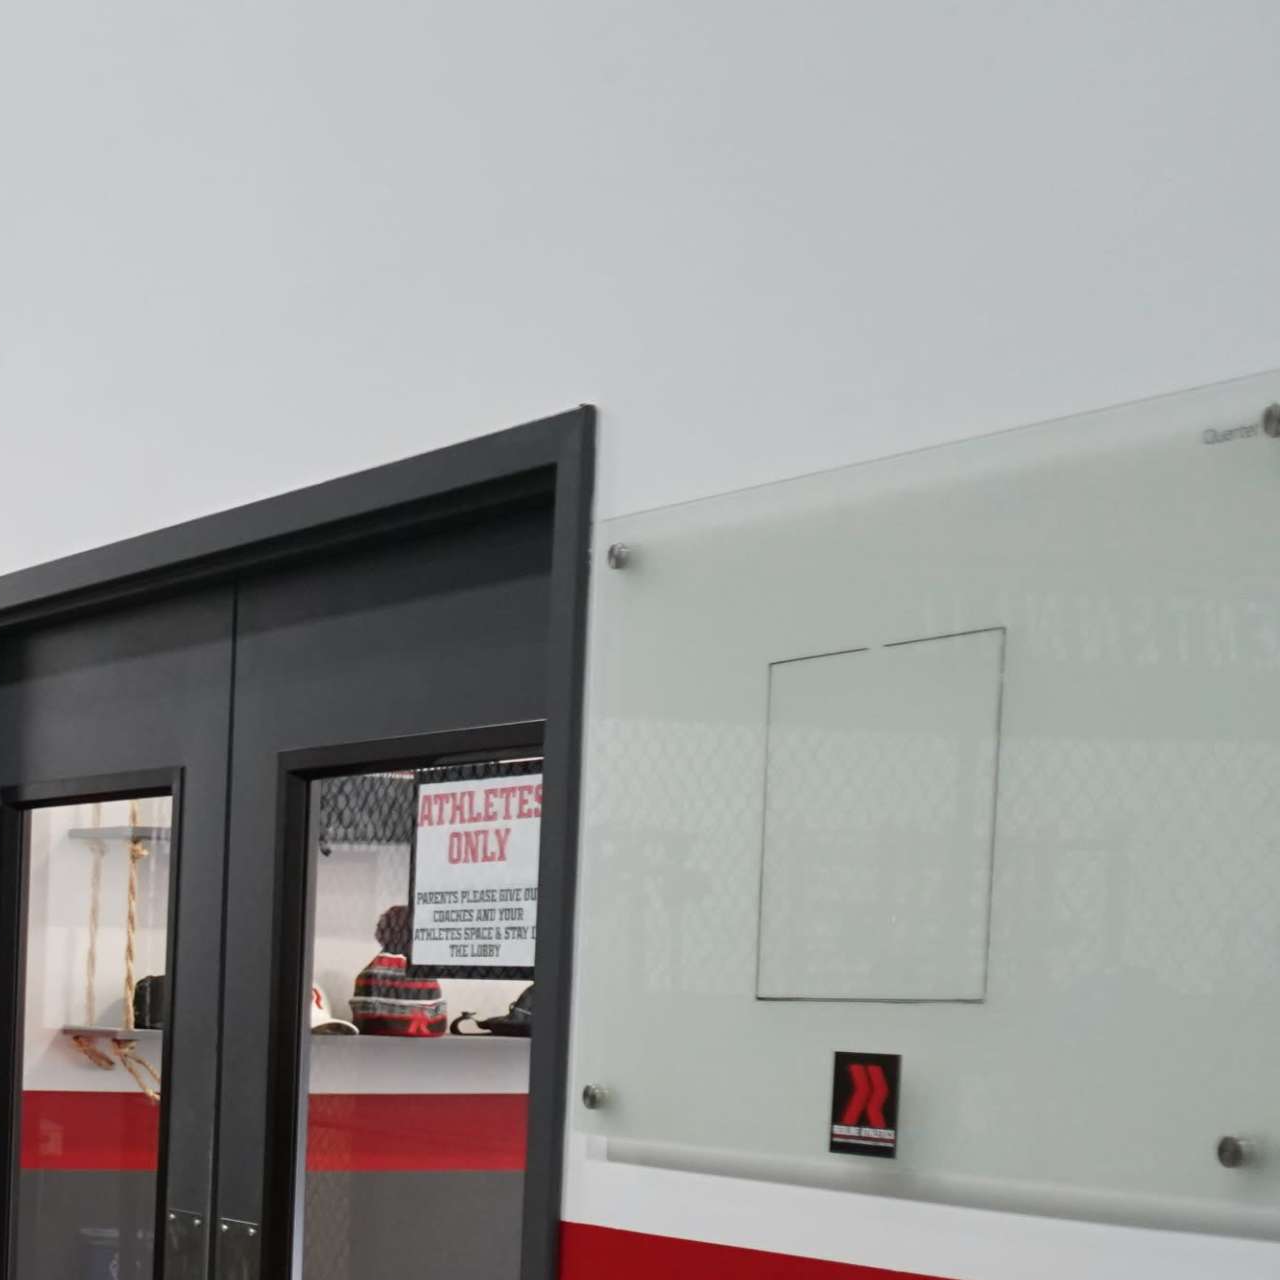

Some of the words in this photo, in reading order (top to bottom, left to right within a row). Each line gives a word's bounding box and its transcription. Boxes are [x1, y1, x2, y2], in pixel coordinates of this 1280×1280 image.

[418, 784, 543, 827] ATHLETES
[448, 828, 511, 865] ONLY
[417, 889, 458, 905] PARENTS
[460, 887, 497, 904] PLEASE
[499, 887, 522, 902] GIVE
[433, 909, 474, 923] COACHES
[475, 908, 496, 922] AND
[497, 907, 524, 921] YOUR
[414, 927, 463, 942] ATHLETES
[464, 926, 494, 941] SPACE
[503, 926, 528, 941] STAY
[449, 944, 469, 958] THE
[470, 944, 501, 958] LOBBY
